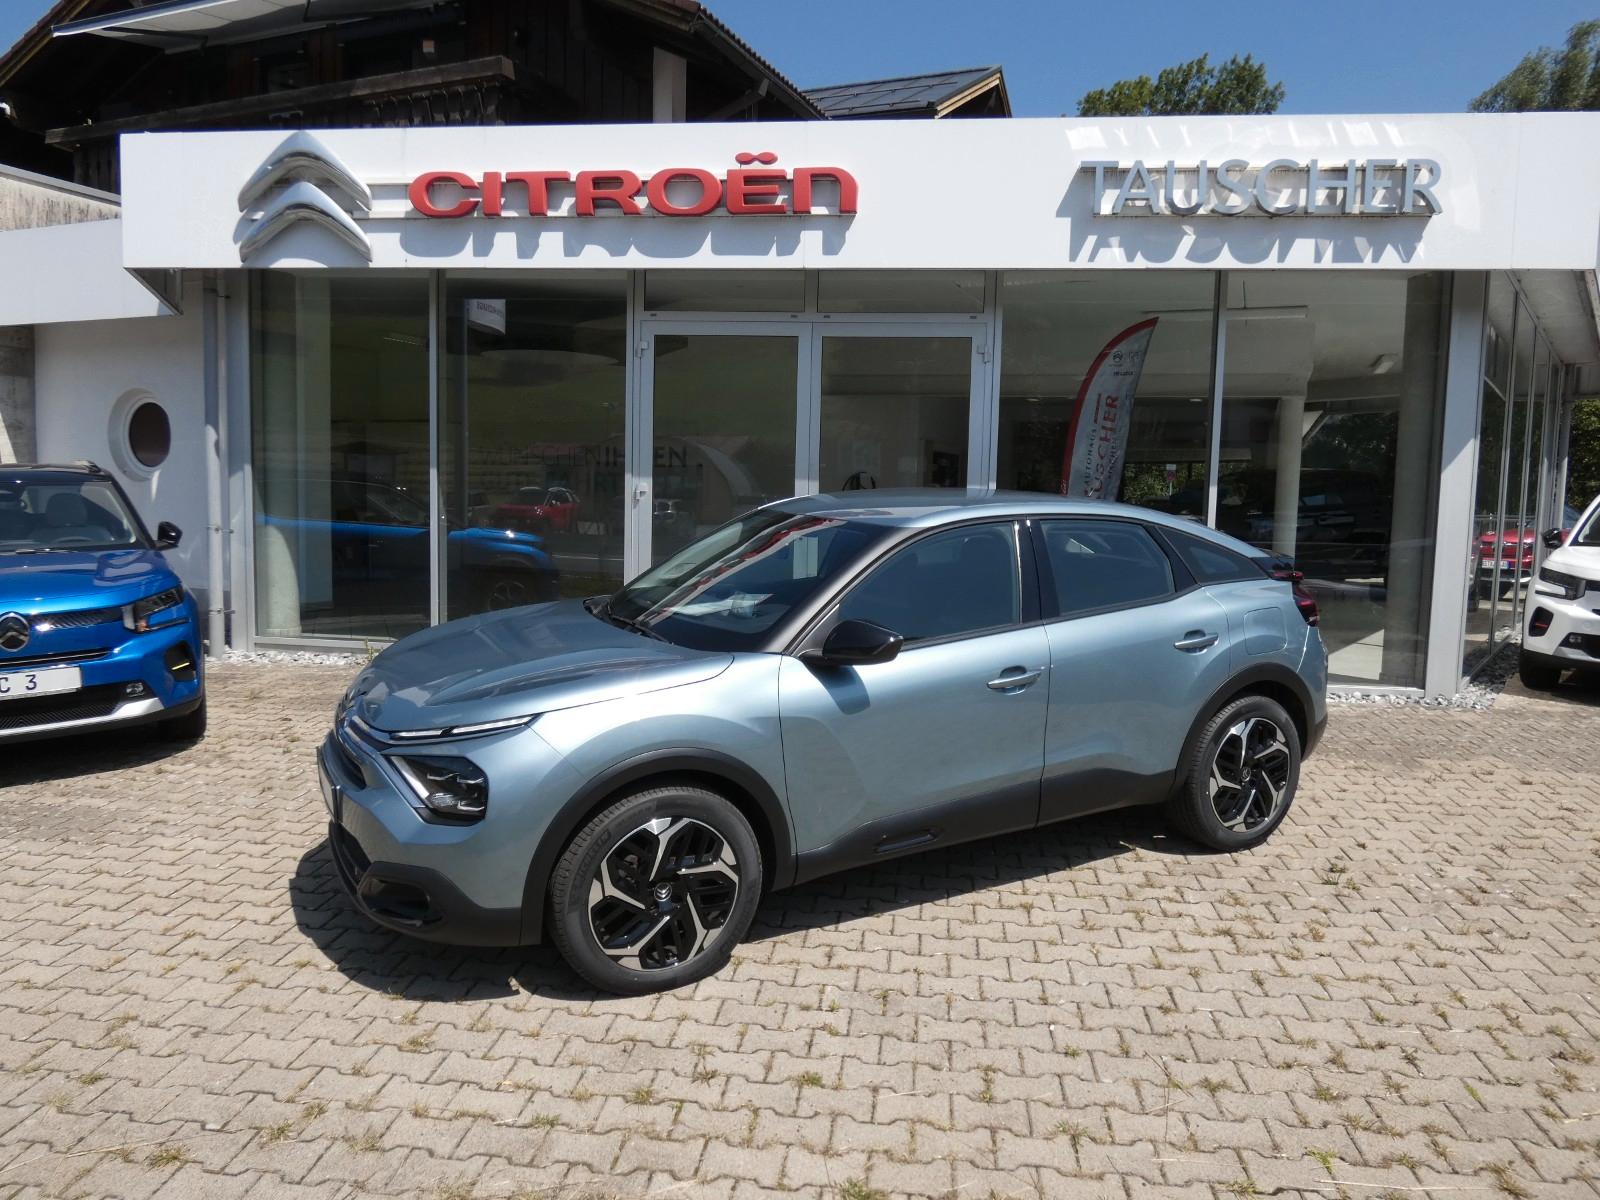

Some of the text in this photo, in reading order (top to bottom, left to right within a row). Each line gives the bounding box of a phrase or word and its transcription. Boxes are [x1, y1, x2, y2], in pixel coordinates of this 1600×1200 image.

[408, 151, 858, 218] CITROËN
[1080, 158, 1443, 216] TAUSCHER
[1095, 394, 1121, 500] USCHER
